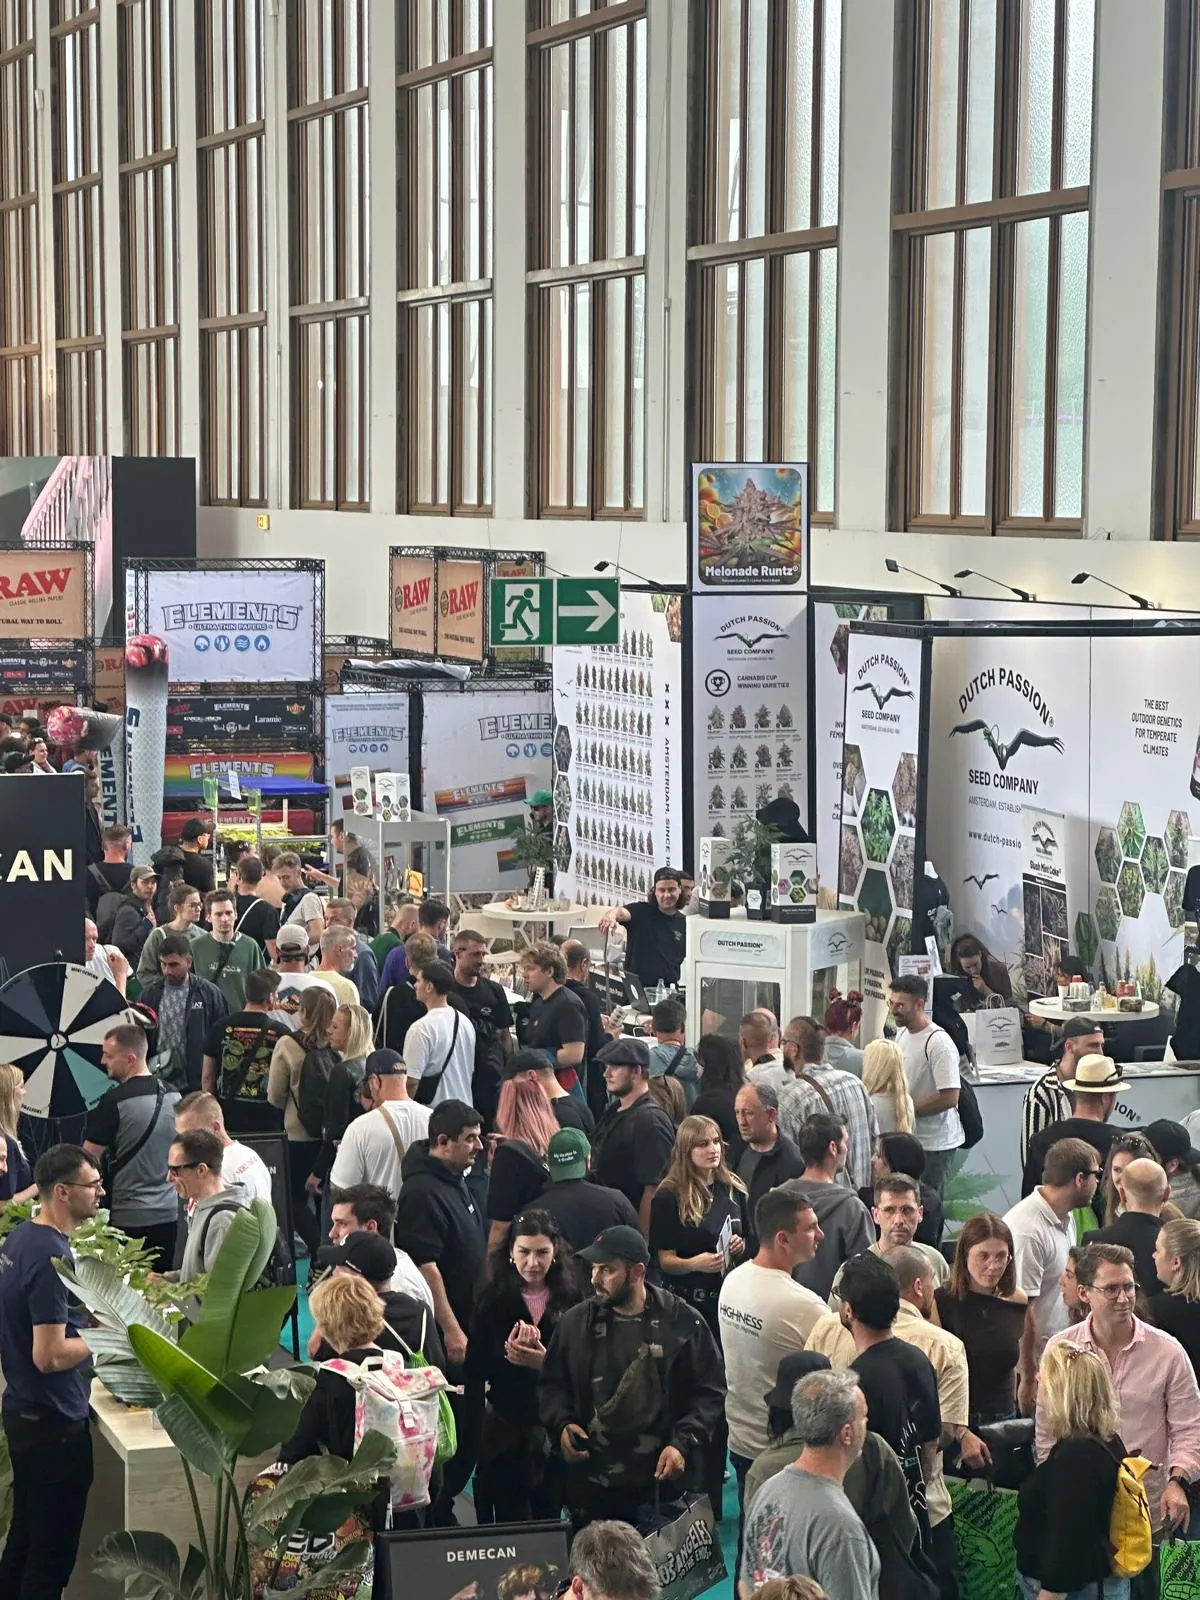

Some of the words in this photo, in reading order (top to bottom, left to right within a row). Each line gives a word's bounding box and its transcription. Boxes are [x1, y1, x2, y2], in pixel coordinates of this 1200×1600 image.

[705, 566, 759, 577] Melonade
[0, 567, 73, 600] RAW
[402, 577, 431, 610] RAW
[449, 581, 479, 615] RAW
[161, 601, 300, 631] ELEMENTS
[720, 616, 746, 633] DUTCH
[858, 655, 880, 680] DUTCH
[959, 668, 996, 714] DUTCH
[213, 702, 250, 711] ELEMENTS
[1144, 699, 1154, 709] THE
[1155, 701, 1169, 711] BEST
[255, 715, 282, 723] Laramie
[861, 709, 875, 719] SEED
[876, 712, 901, 723] COMPANY
[1131, 712, 1156, 724] OUTDOOR
[1156, 715, 1182, 728] GENETICS
[332, 726, 405, 743] ELEMENTS
[1135, 727, 1146, 738] FOR
[1147, 729, 1177, 743] TEMPERATE
[1143, 743, 1169, 757] CLIMATES
[189, 762, 275, 779] ELEMENTS
[968, 768, 991, 786] SEED
[993, 772, 1039, 795] COMPANY
[452, 783, 505, 800] ELEMENTS
[456, 821, 505, 837] ELEMENTS
[0, 848, 73, 882] AN
[720, 1304, 763, 1331] HIGHNESS
[446, 1546, 516, 1562] DEMECAN
[676, 1520, 712, 1573] ANGELES
